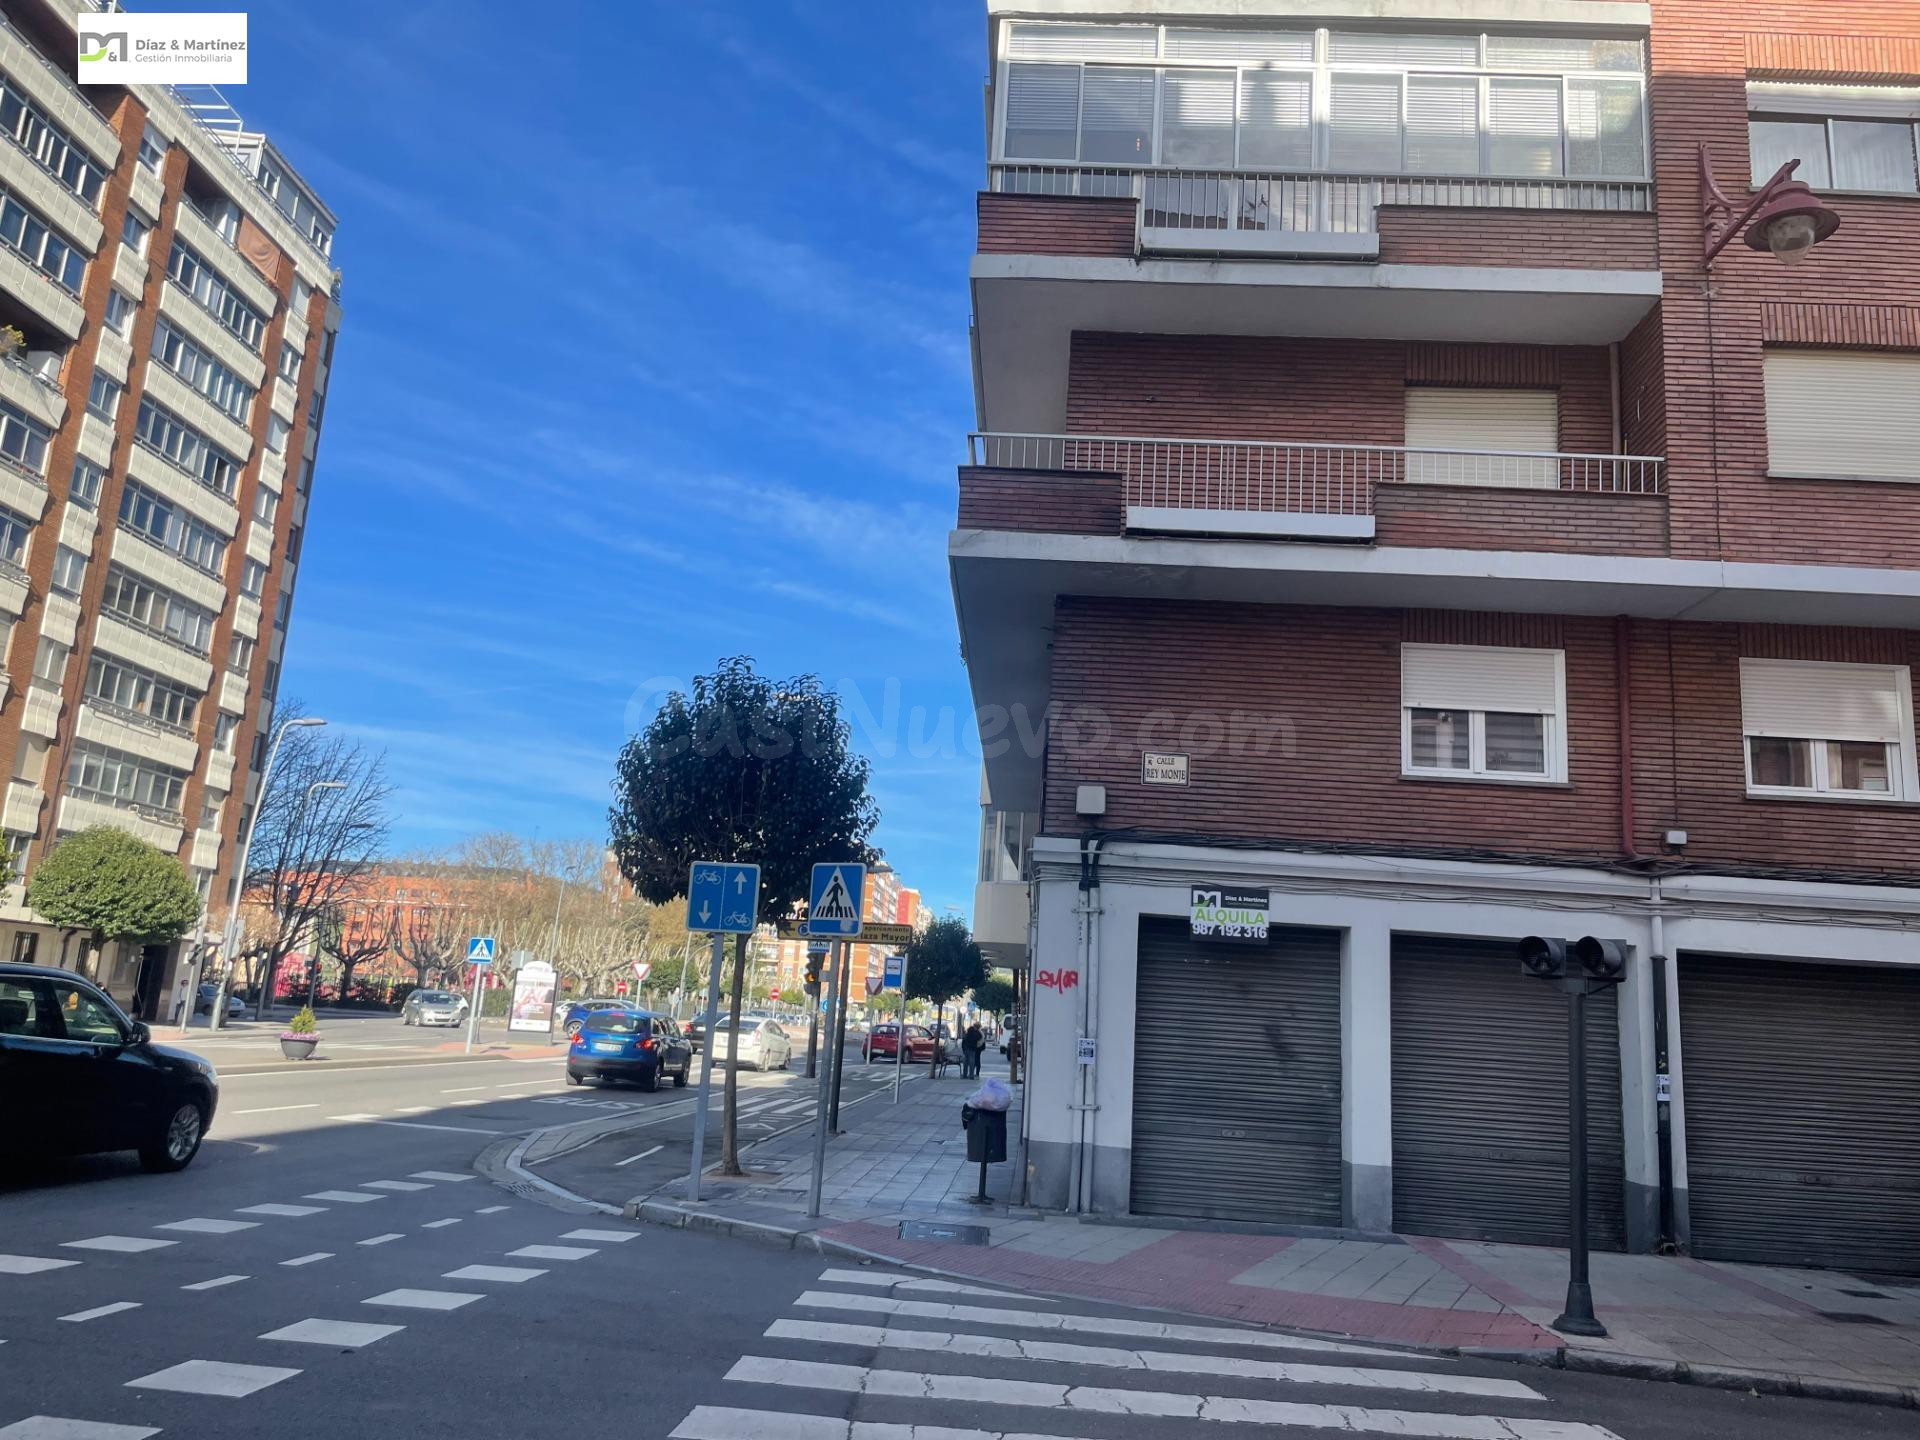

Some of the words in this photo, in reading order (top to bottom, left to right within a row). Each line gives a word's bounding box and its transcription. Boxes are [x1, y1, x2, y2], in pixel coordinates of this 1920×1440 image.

[1156, 757, 1175, 765] CALLE
[1146, 768, 1159, 778] REY
[1161, 769, 1186, 781] MONJE
[1195, 908, 1265, 925] ALQUILA
[1192, 923, 1216, 935] 987
[1219, 924, 1241, 937] 192
[1244, 926, 1267, 938] 316
[882, 933, 910, 942] Mayor
